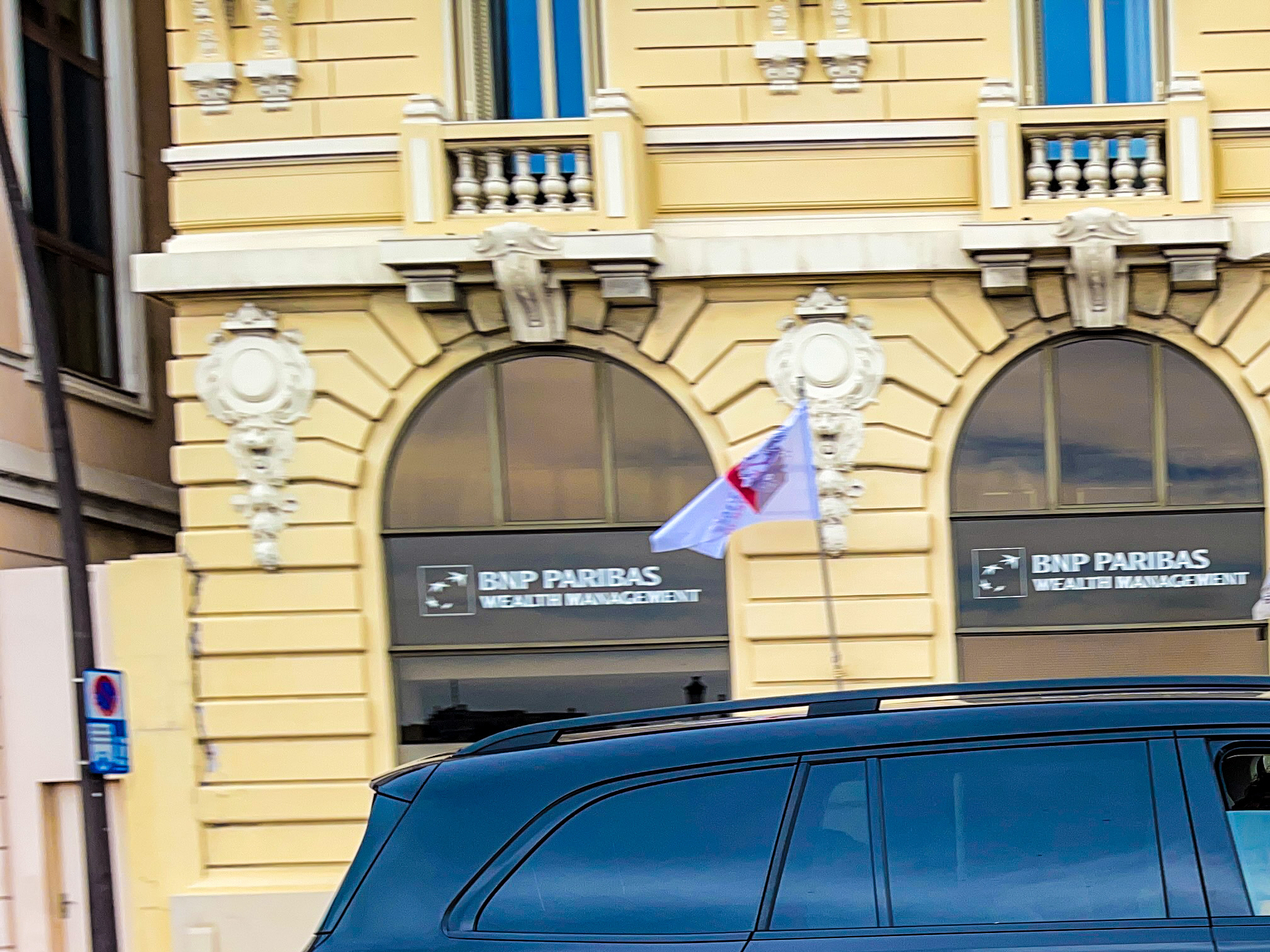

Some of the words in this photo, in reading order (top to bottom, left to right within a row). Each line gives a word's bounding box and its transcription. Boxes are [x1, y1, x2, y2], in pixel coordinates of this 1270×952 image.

[1031, 553, 1090, 574] BNP
[1093, 549, 1211, 571] PARIBAS
[478, 569, 539, 591] BNP
[542, 566, 662, 589] PARIBAS
[1032, 576, 1112, 591] WEALTH
[1114, 572, 1249, 589] MANAGEMENT
[479, 593, 563, 609] WEALTH
[564, 589, 702, 607] MANAGEMENT
